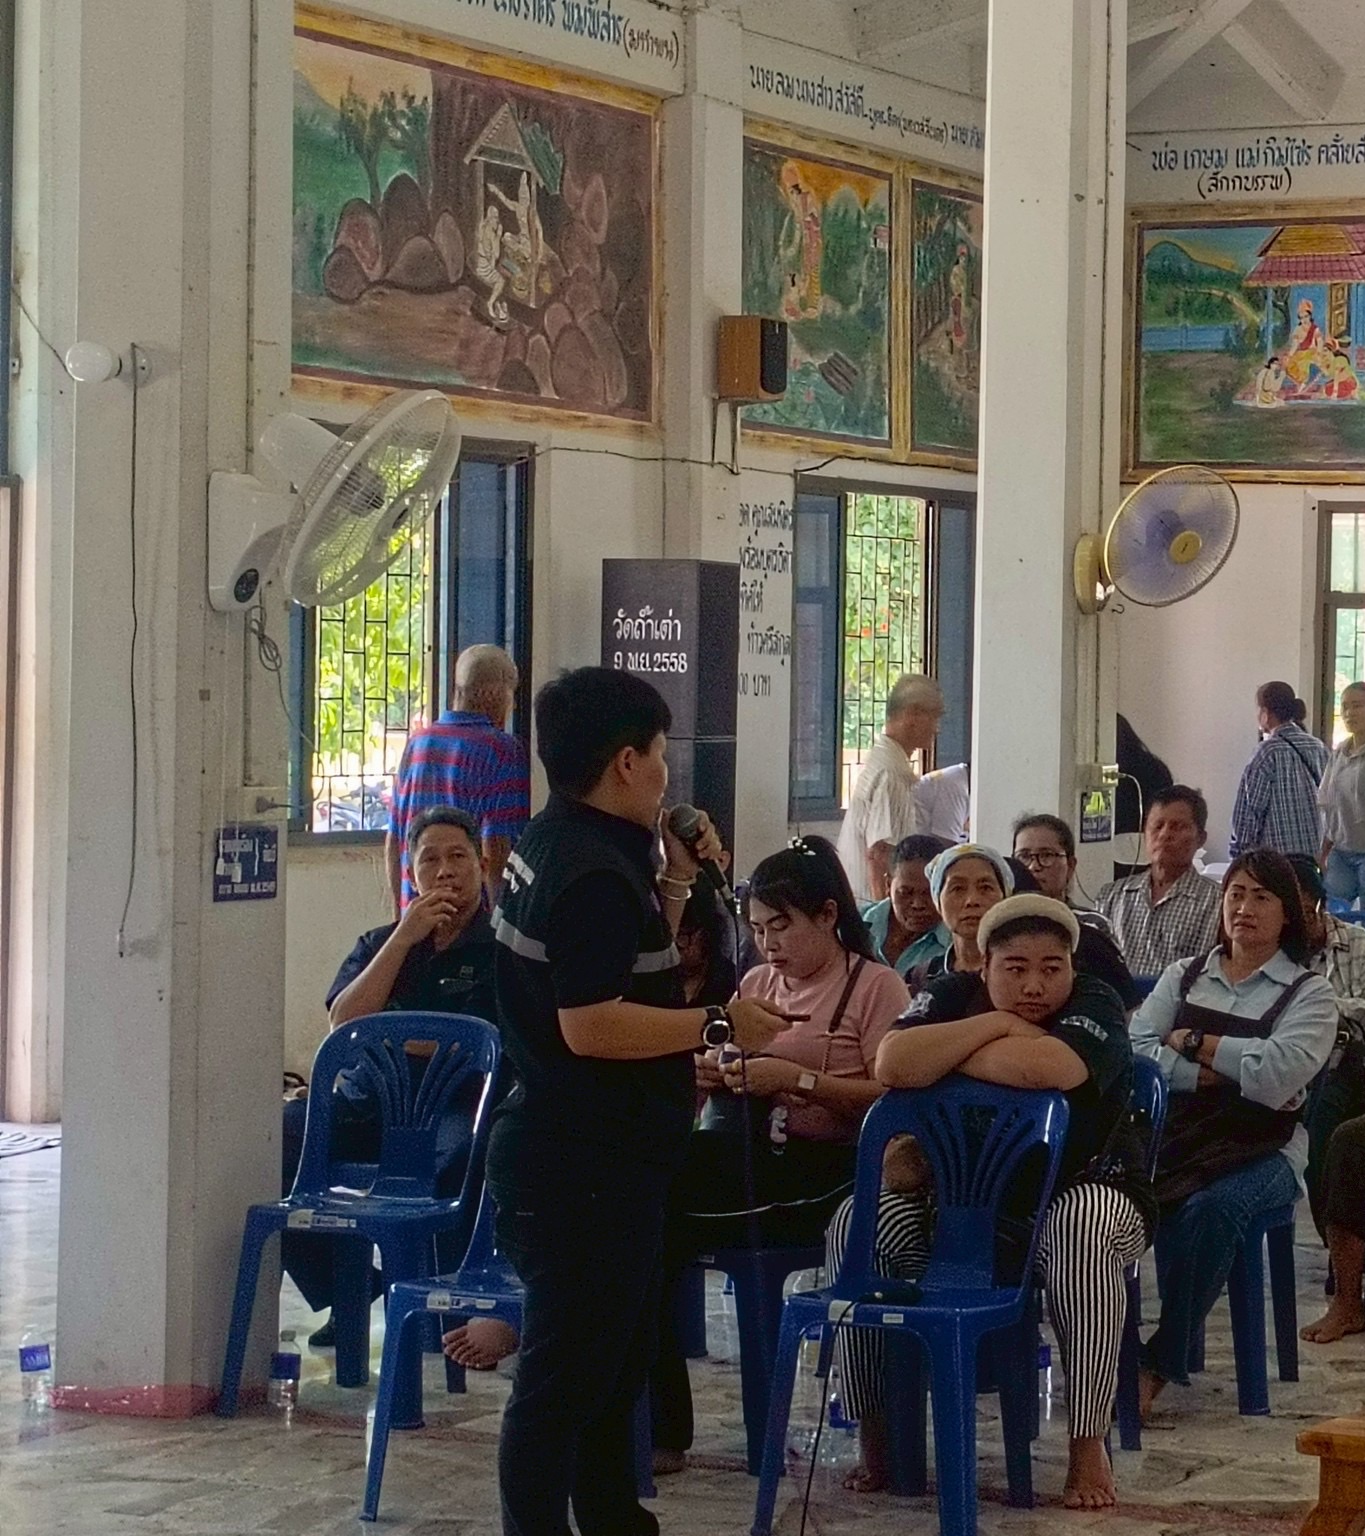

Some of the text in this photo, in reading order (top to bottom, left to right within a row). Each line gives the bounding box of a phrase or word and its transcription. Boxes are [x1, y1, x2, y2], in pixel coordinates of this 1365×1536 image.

[612, 604, 682, 641] วัดถ้ำเต่า
[653, 652, 688, 675] 2558
